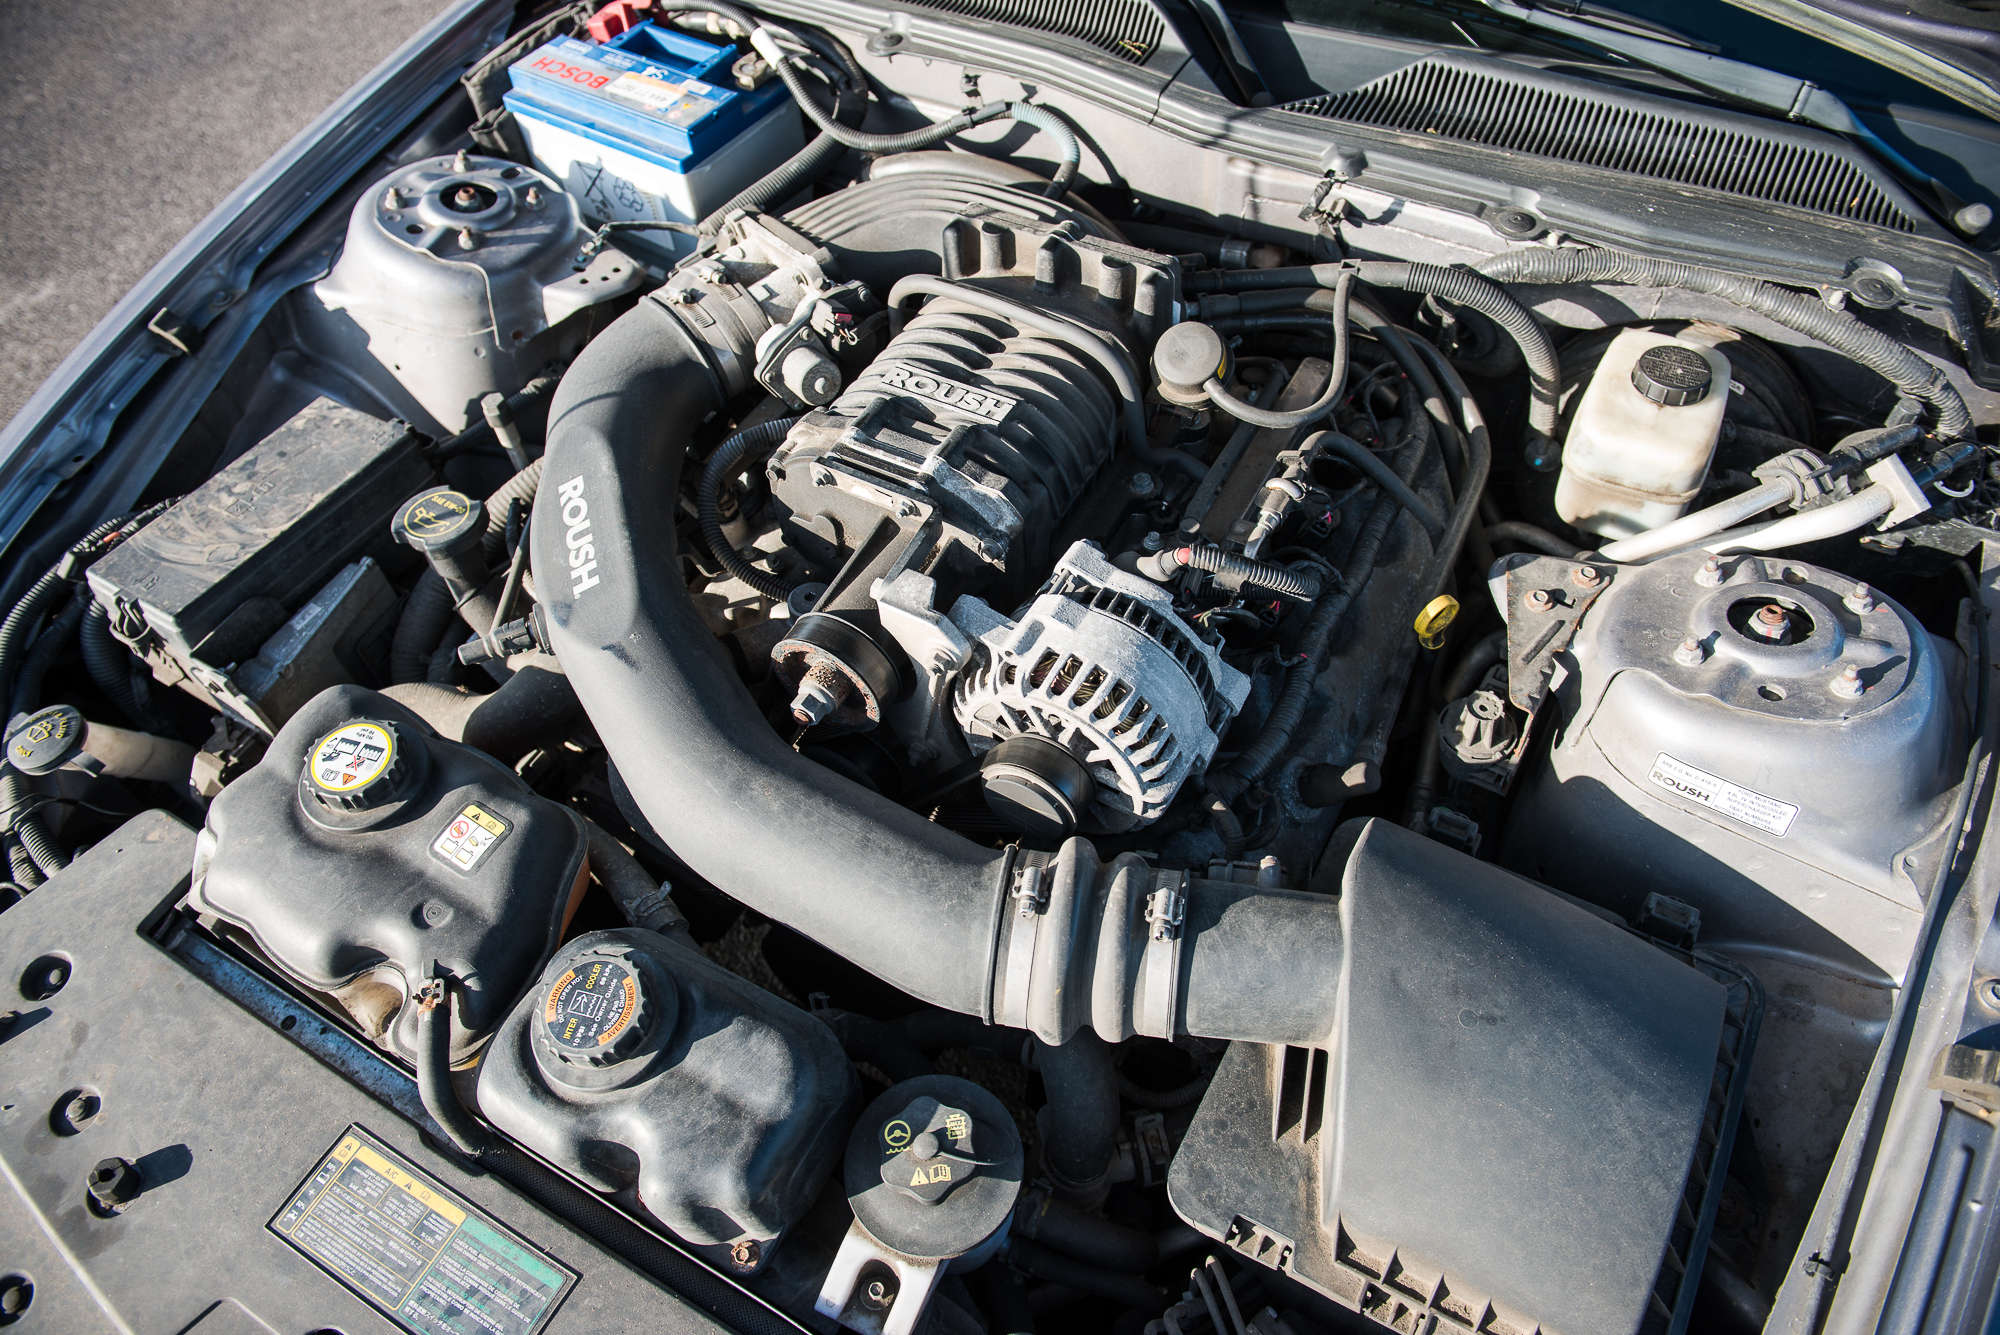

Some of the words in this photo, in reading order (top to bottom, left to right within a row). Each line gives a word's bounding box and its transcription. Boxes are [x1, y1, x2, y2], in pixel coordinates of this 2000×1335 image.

[531, 56, 610, 89] BOSCH
[883, 367, 1014, 420] ROUSH
[557, 474, 600, 599] ROUSH
[1652, 770, 1710, 802] ROUSH
[549, 974, 572, 1010] WARNING
[560, 984, 573, 1000] OPEN
[571, 975, 583, 985] HOT
[563, 1017, 578, 1040] INTER
[585, 963, 602, 989] COOLER
[588, 1023, 598, 1036] See
[595, 1000, 608, 1022] Owner
[605, 978, 618, 998] Guide
[607, 981, 635, 1038] AVERTISSEMENT
